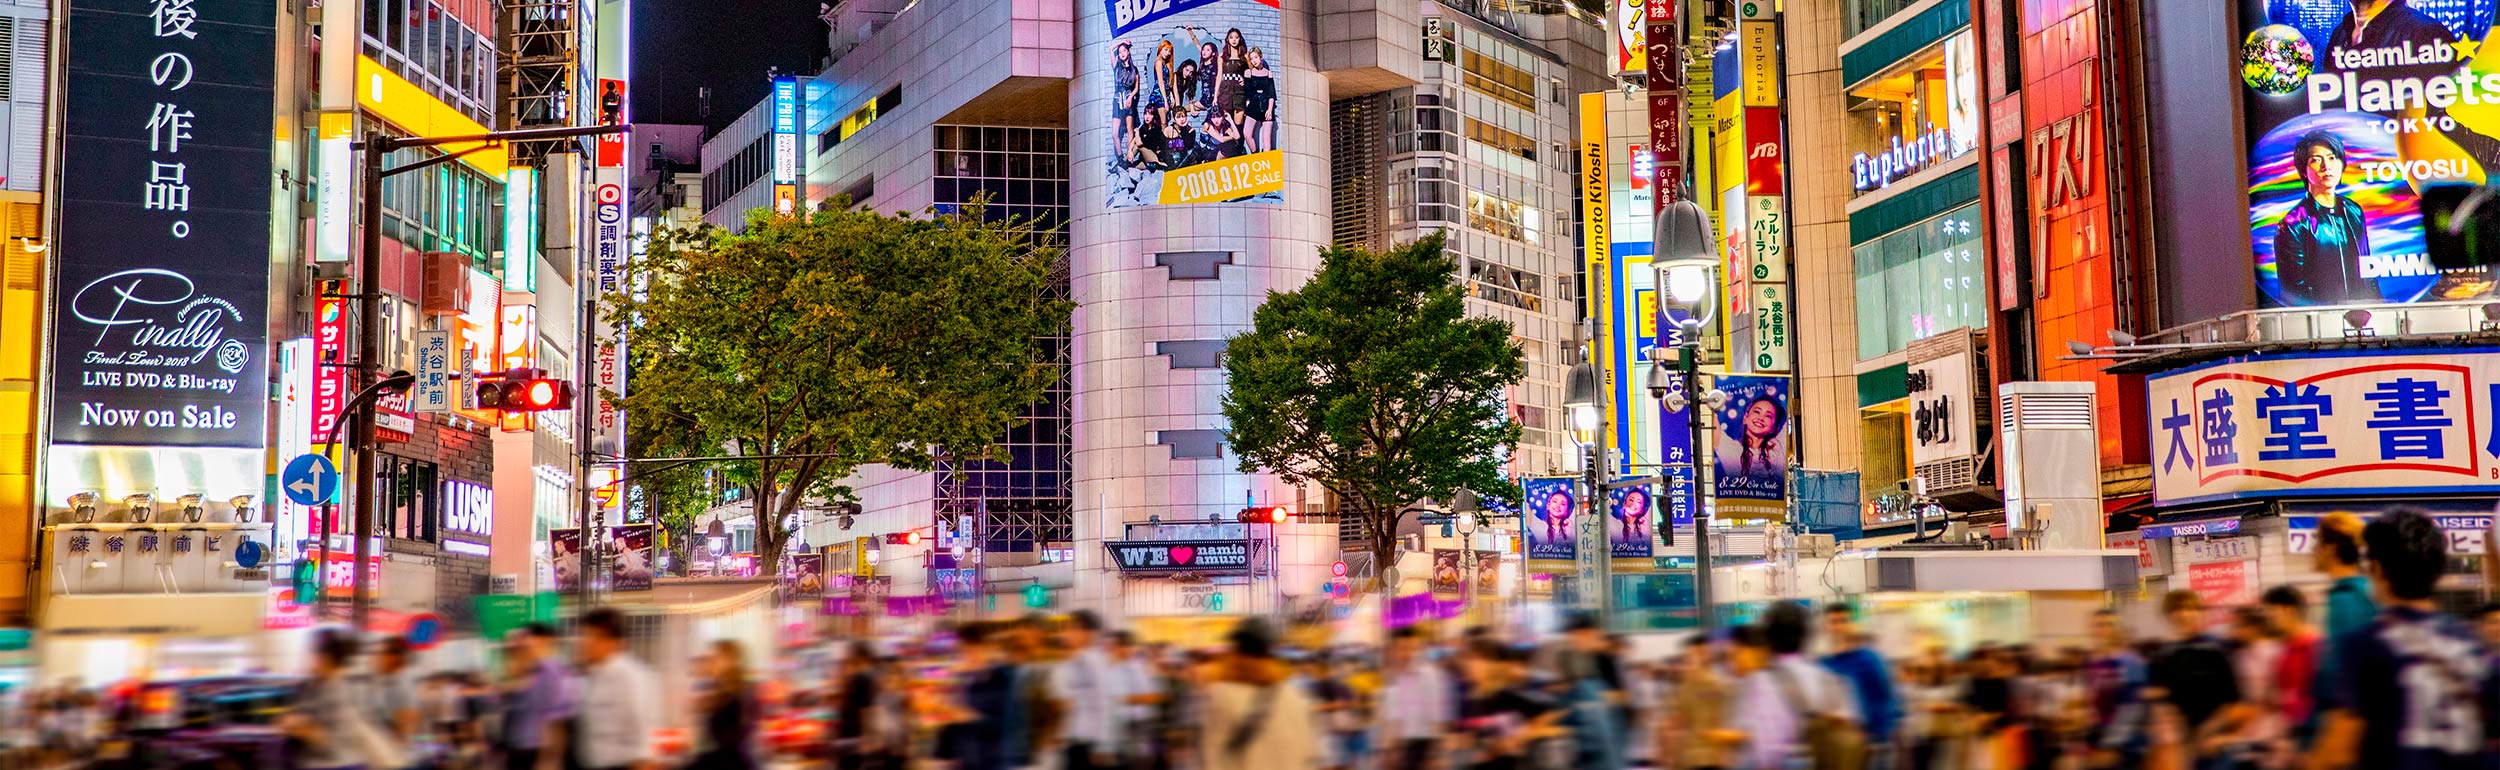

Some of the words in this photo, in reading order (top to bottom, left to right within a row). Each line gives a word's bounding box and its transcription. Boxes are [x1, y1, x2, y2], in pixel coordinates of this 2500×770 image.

[1746, 5, 1755, 15] 5F
[1654, 26, 1668, 34] 6F
[1753, 27, 1765, 91] Euphoria
[2332, 38, 2454, 70] teamLab
[1657, 98, 1669, 106] 6F
[2307, 65, 2500, 115] Planets
[146, 0, 199, 239] 後の作品。
[2367, 116, 2456, 135] TOKYO
[1750, 142, 1778, 160] JTB
[1853, 122, 1948, 191] Euphoria
[1252, 160, 1271, 172] ON
[1255, 171, 1281, 186] SALE
[1589, 143, 1602, 204] KiYoshi
[1660, 168, 1673, 178] 6F
[2360, 158, 2469, 183] TOYOSU
[1177, 162, 1253, 202] 2018.9.12
[1754, 219, 1766, 262] パーラー
[1768, 213, 1780, 256] フルーツ
[600, 226, 617, 292] 調剤薬局
[1758, 308, 1770, 350] フルーツ
[1771, 301, 1784, 347] 渋谷西村
[84, 351, 126, 365] Final
[164, 357, 189, 366] 2018
[419, 347, 428, 379] Shibuya
[429, 336, 444, 405] 渋谷駅前
[83, 371, 121, 386] LIVE
[126, 373, 160, 387] DVD
[162, 374, 176, 388] &
[178, 374, 237, 393] Blu-ray
[419, 382, 427, 395] Sta
[463, 352, 472, 408] スクランブル式
[80, 402, 140, 426] Now
[143, 409, 176, 426] on
[181, 405, 237, 428] Sale
[1719, 476, 1747, 489] 8.29
[447, 480, 492, 536] LUSH
[2172, 525, 2206, 536] TAISEIDO
[1121, 547, 1168, 566] WE
[1195, 554, 1246, 565] amuro
[1196, 544, 1245, 555] namie
[1582, 523, 1593, 593] 文化村通り
